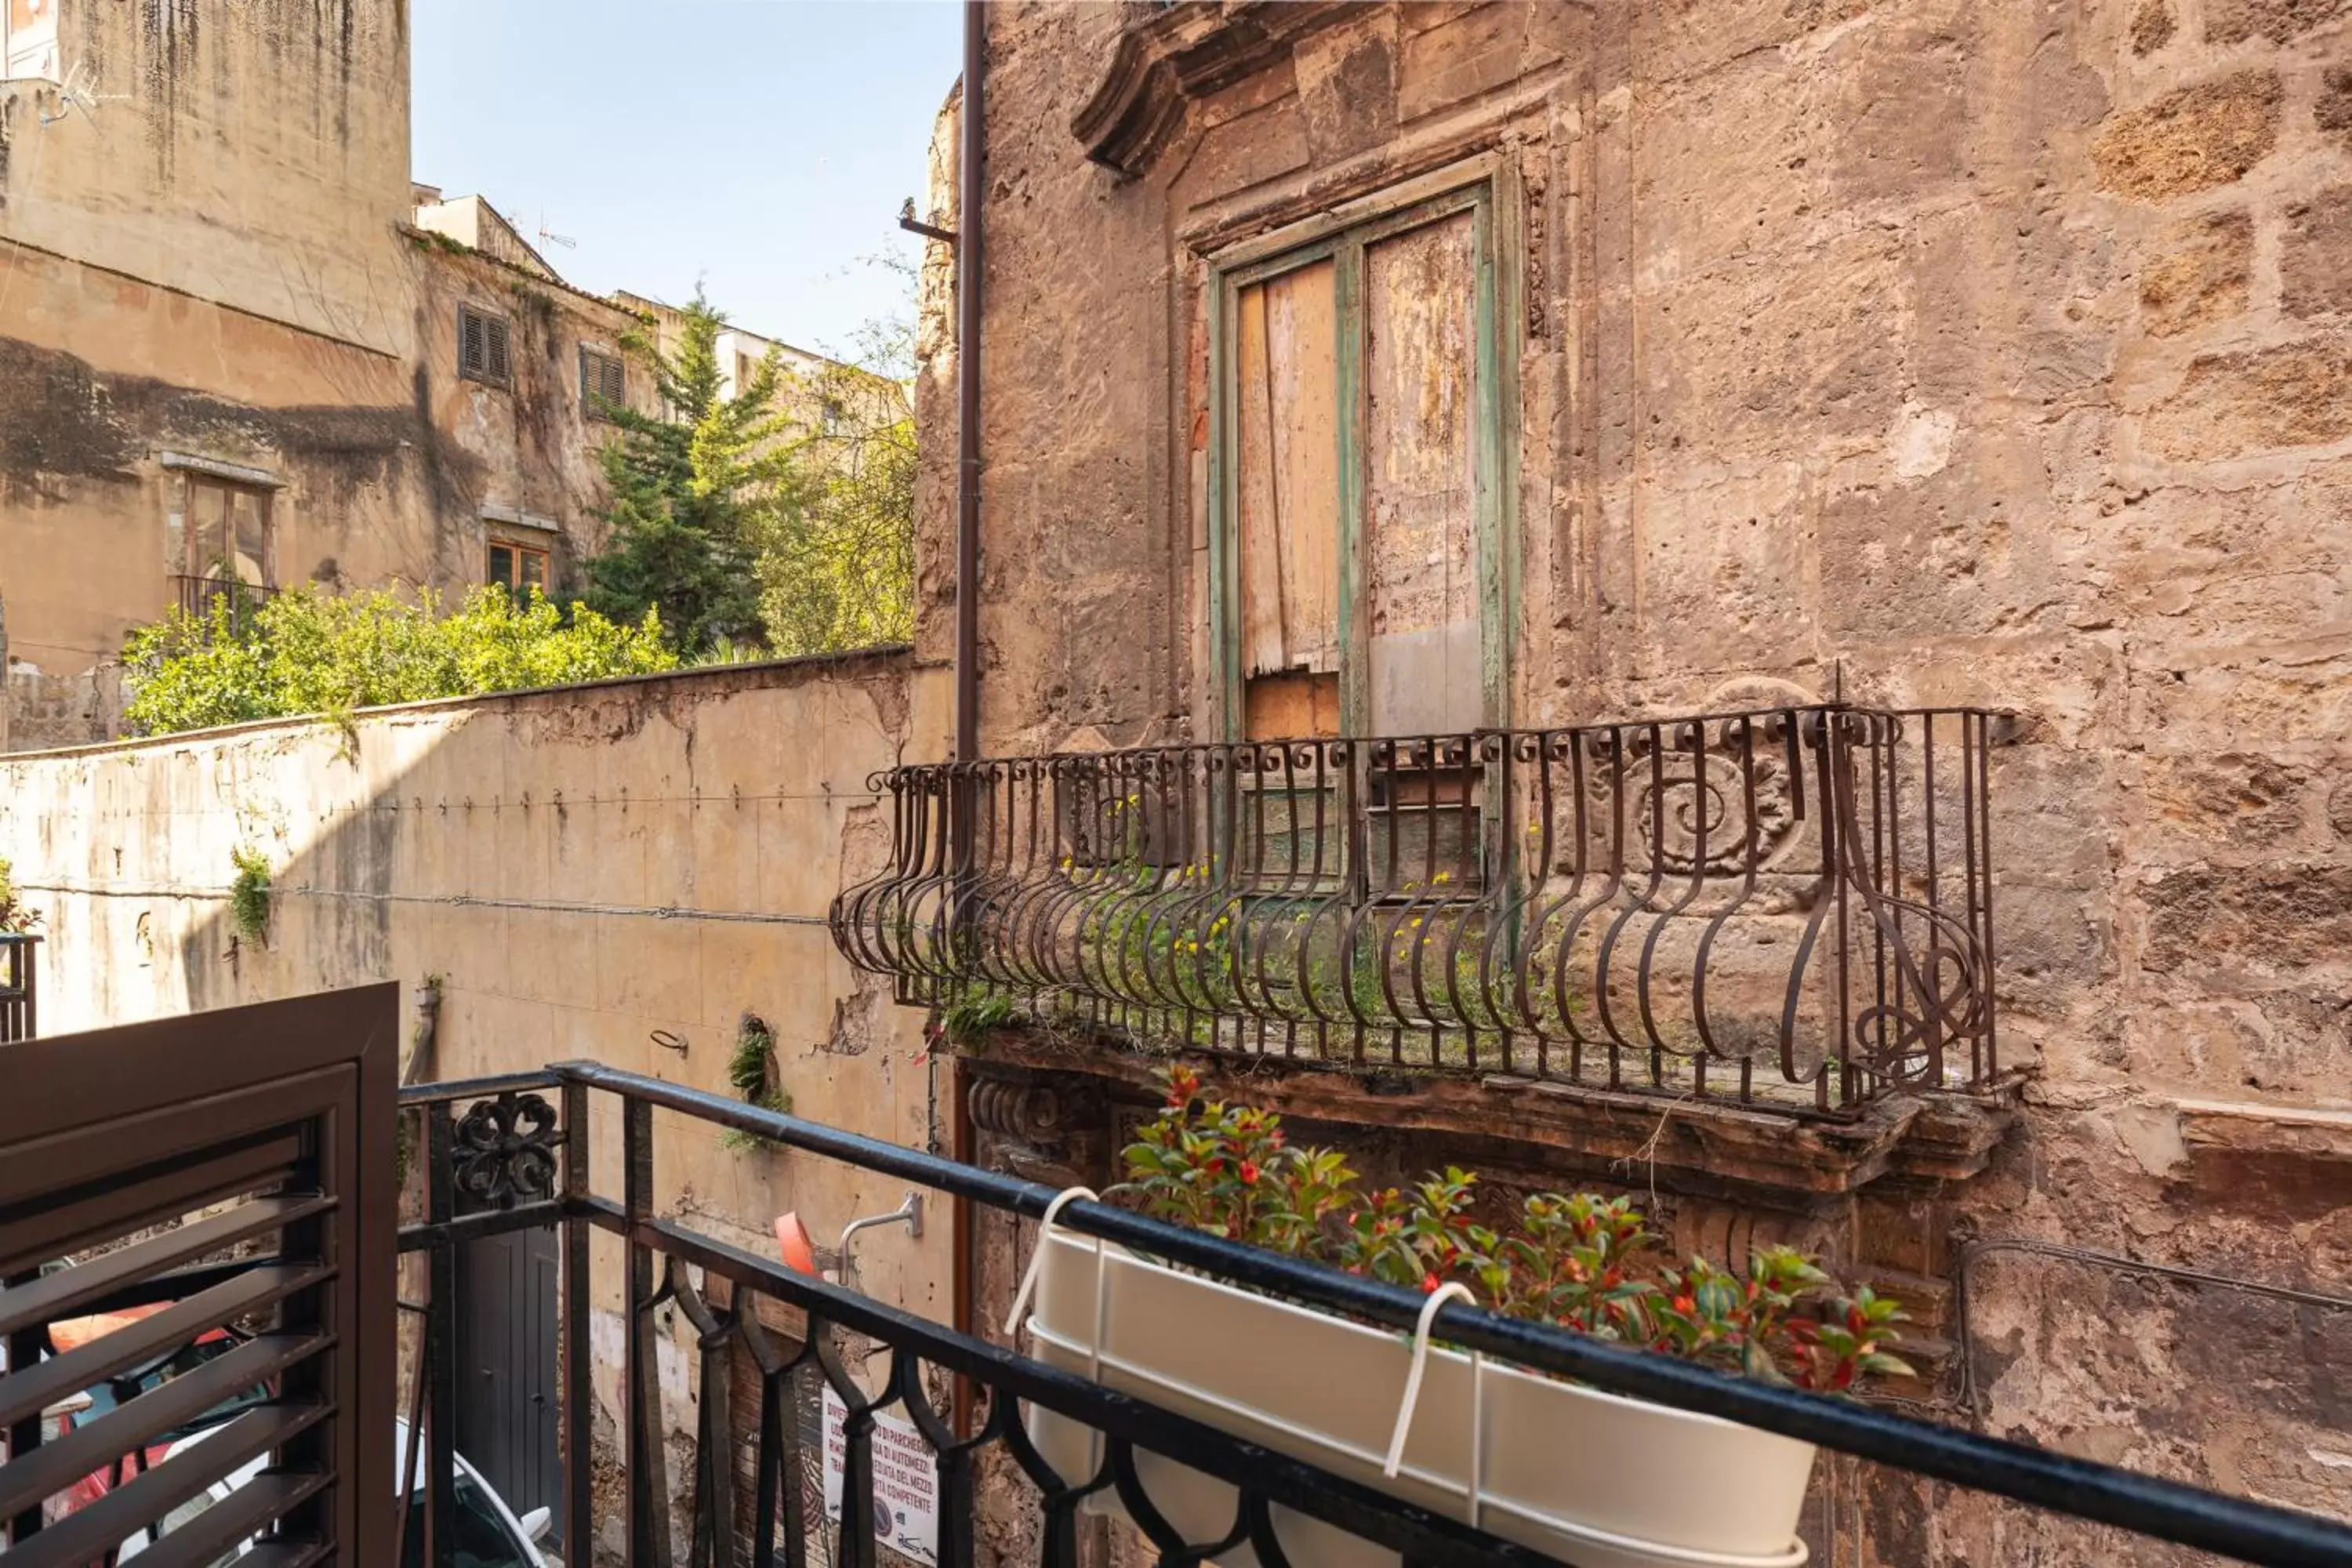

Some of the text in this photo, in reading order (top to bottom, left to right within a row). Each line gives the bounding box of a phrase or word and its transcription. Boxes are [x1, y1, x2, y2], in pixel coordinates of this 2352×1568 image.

[883, 1426, 890, 1440] DI
[884, 1445, 891, 1459] DI
[892, 1449, 930, 1475] AUTOMEZZI
[897, 1469, 909, 1486] DEL
[910, 1474, 933, 1494] MEZZO
[887, 1484, 931, 1514] COMPETENTE
